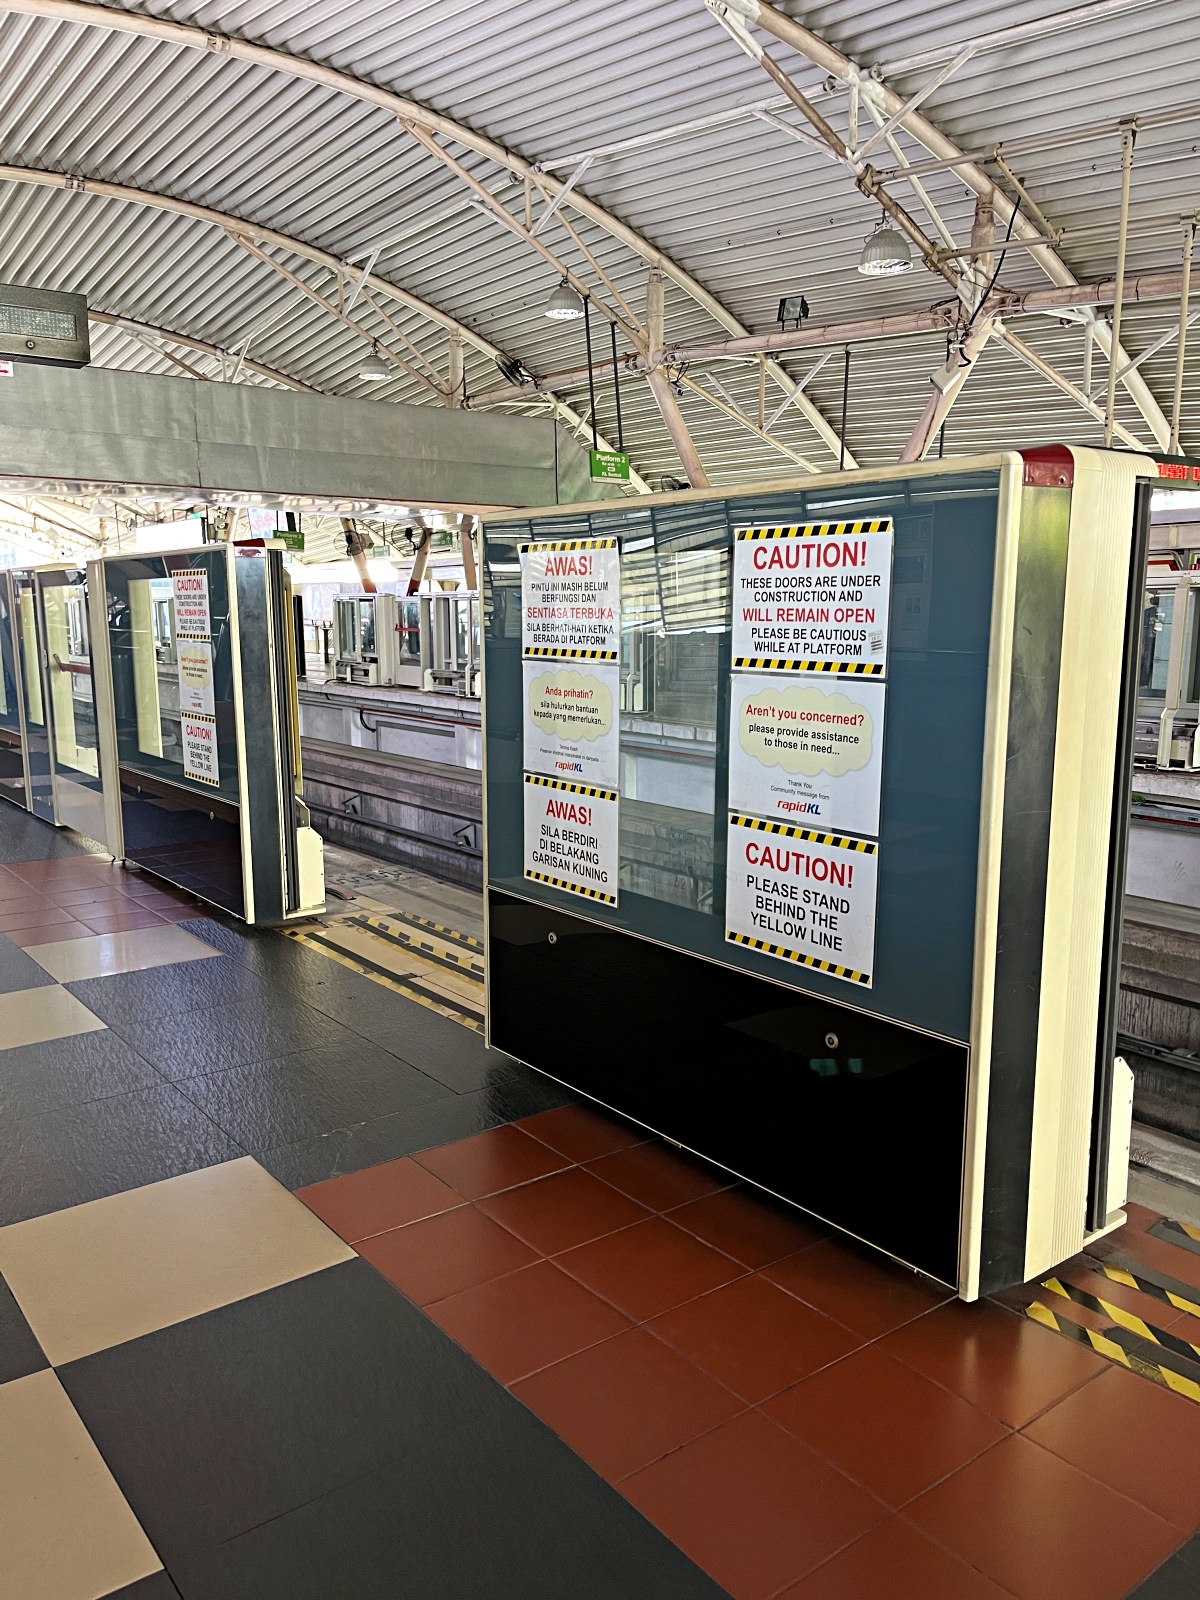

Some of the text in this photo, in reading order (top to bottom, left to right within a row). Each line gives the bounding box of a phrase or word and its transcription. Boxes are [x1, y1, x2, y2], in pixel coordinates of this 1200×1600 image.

[596, 454, 620, 462] Platform
[754, 541, 866, 570] CAUTION!
[544, 556, 592, 576] AWAS!
[177, 579, 203, 591] CAUTION!
[532, 582, 608, 592] PINTU INI MASIH BELUM
[741, 575, 881, 588] THESE DOORS ARE UNDER
[542, 594, 596, 603] BERFUNGSI DAN
[754, 591, 862, 602] CONSTRUCTION AND
[528, 607, 614, 620] SENTIASA TERBUKA
[742, 608, 875, 623] WILL REMAIN OPEN
[527, 623, 614, 634] SILA BERHATI-HATI KETIKA
[751, 628, 866, 641] PLEASE BE CAUTIOUS
[534, 634, 606, 645] BERADA DI PLATFORM
[754, 642, 785, 653] WHILE
[788, 643, 800, 653] AT
[803, 643, 862, 656] PLATFORM
[545, 686, 593, 699] Anda prihatin?
[540, 700, 598, 714] sila hulurkan bantuan
[534, 710, 606, 726] kepada yang memerlukan...
[746, 704, 864, 726] Aren't you concerned?
[186, 725, 212, 741] CAUTION!
[749, 723, 859, 744] please provide assistance
[764, 737, 840, 755] to those in need...
[555, 762, 583, 772] rapidKL
[771, 785, 796, 796] Community
[797, 790, 817, 799] message
[546, 799, 592, 826] AWAS!
[777, 800, 821, 815] rapidKL
[541, 824, 598, 849] SILA BERDIRI
[540, 839, 599, 864] DI BELAKANG
[533, 851, 608, 882] GARISAN KUNING
[745, 843, 853, 888] CAUTION!
[747, 875, 850, 914] PLEASE STAND
[756, 895, 838, 931] BEHIND THE
[751, 911, 842, 952] YELLOW LINE
